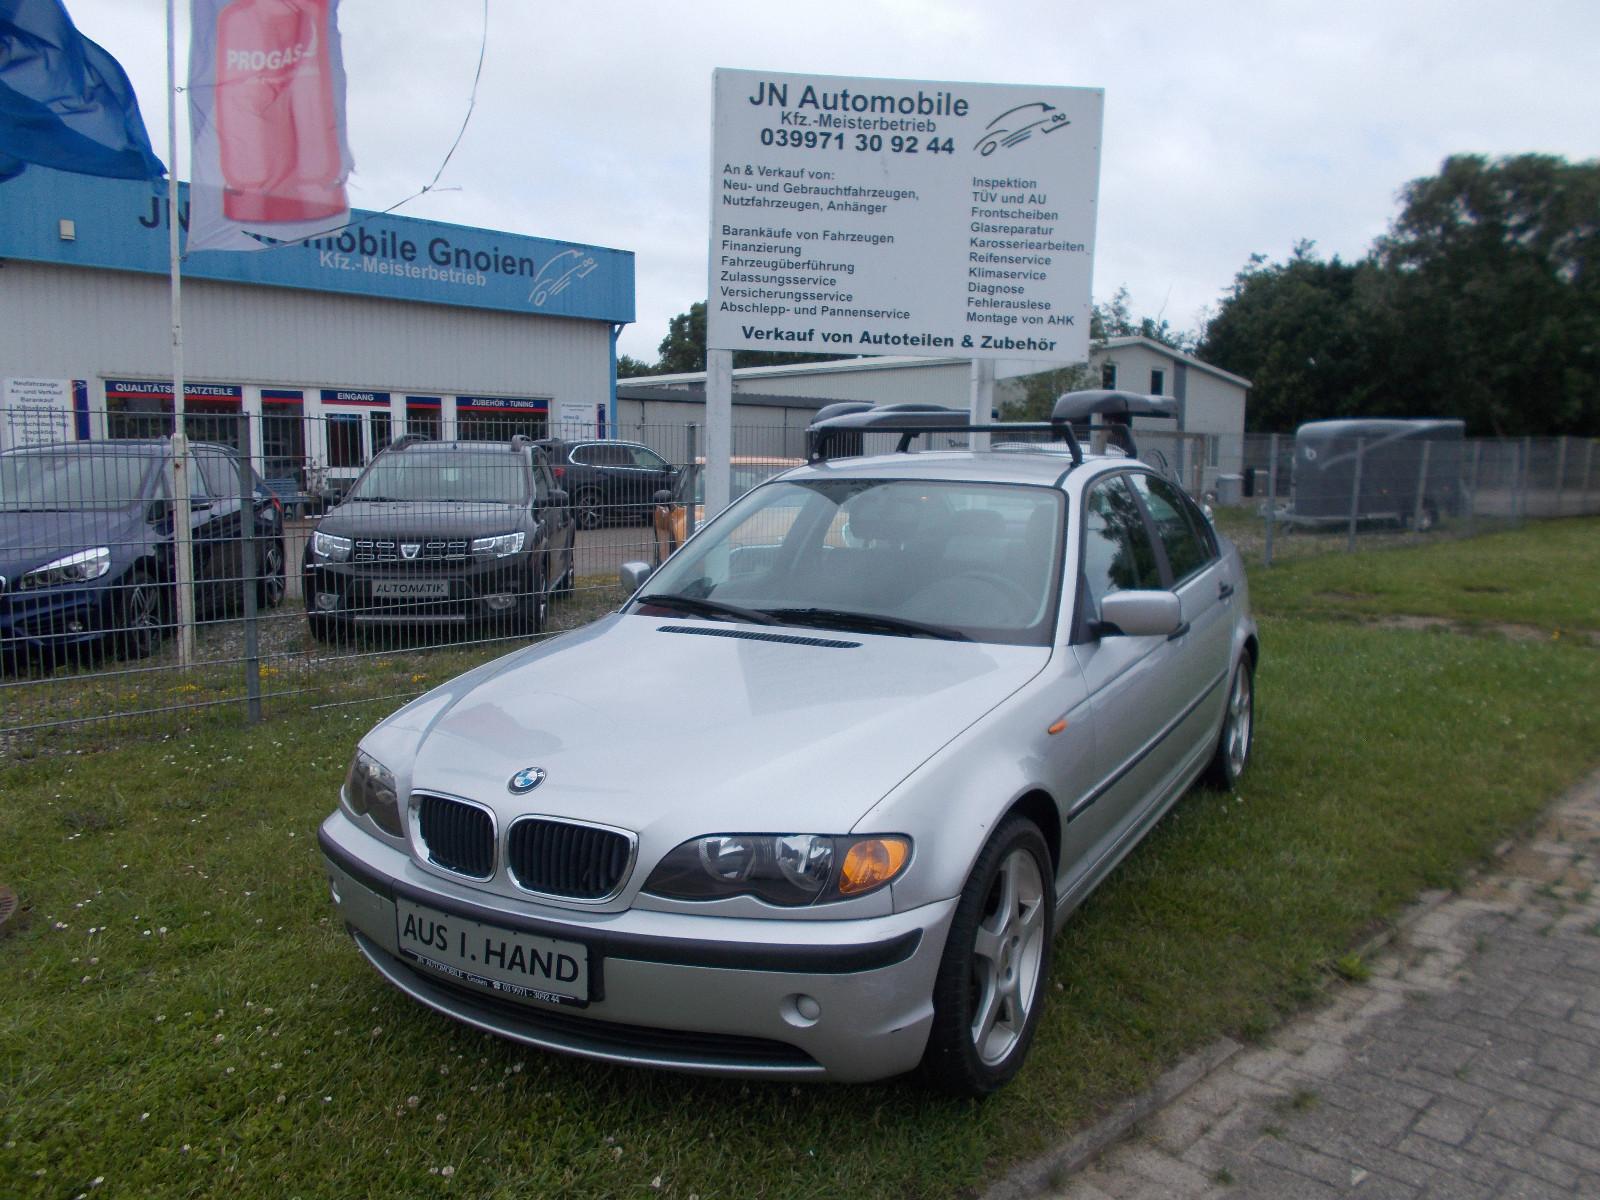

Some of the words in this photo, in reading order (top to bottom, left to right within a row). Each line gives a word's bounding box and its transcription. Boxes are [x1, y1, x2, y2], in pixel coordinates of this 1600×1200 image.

[227, 43, 304, 72] PROGAS
[749, 81, 788, 107] JN
[798, 85, 969, 117] Automobile
[781, 111, 936, 133] Kfz.-Meisterbetrieb
[760, 128, 845, 150] 039971
[855, 134, 882, 152] 30
[891, 136, 919, 154] 92
[926, 137, 955, 155] 44
[723, 163, 741, 176] An
[744, 165, 754, 176] &
[757, 166, 804, 179] Verkauf
[808, 171, 835, 180] von:
[723, 180, 752, 192] Neu-
[756, 182, 779, 192] und
[783, 183, 919, 201] Gebrauchtfahrzeugen,
[972, 176, 1037, 190] Inspektion
[723, 195, 823, 212] Nutzfahrzeugen,
[827, 201, 887, 214] Anhänger
[972, 189, 997, 202] TÜV
[1001, 194, 1024, 204] und
[1028, 194, 1047, 205] AU
[971, 207, 1058, 221] Frontscheiben
[722, 225, 792, 239] Barankäufe
[796, 231, 819, 240] von
[823, 230, 894, 245] Fahrzeugen
[970, 222, 1054, 236] Glasreparatur
[722, 240, 802, 257] Finanzierung
[970, 237, 1085, 252] Karosseriearbeiten
[428, 237, 535, 277] Gnoien
[721, 256, 855, 274] Fahrzeugüberführung
[969, 252, 1051, 265] Reifenservice
[319, 251, 486, 287] Kfz.-Meisterbetrieb
[968, 267, 1047, 280] Klimaservice
[720, 271, 837, 286] Zulassungsservice
[720, 286, 853, 302] Versicherungsservice
[968, 282, 1025, 295] Diagnose
[720, 301, 790, 316] Abschlepp-
[794, 306, 817, 315] und
[821, 305, 911, 319] Pannenservice
[967, 297, 1051, 310] Fehlerauslese
[966, 312, 1018, 326] Montage
[1022, 316, 1043, 325] von
[1047, 315, 1075, 326] AHK
[742, 325, 815, 342] Verkauf
[821, 331, 853, 343] von
[859, 331, 954, 347] Autoteilen
[961, 335, 974, 348] &
[980, 335, 1057, 351] Zubehör
[115, 383, 233, 396] QUALITÄTSESATZTEILE
[337, 392, 374, 401] EINGANG
[472, 399, 504, 407] ZUBEHÖR
[376, 583, 445, 593] AUTOMATIK
[403, 913, 448, 952] AUS
[484, 937, 579, 983] HAND
